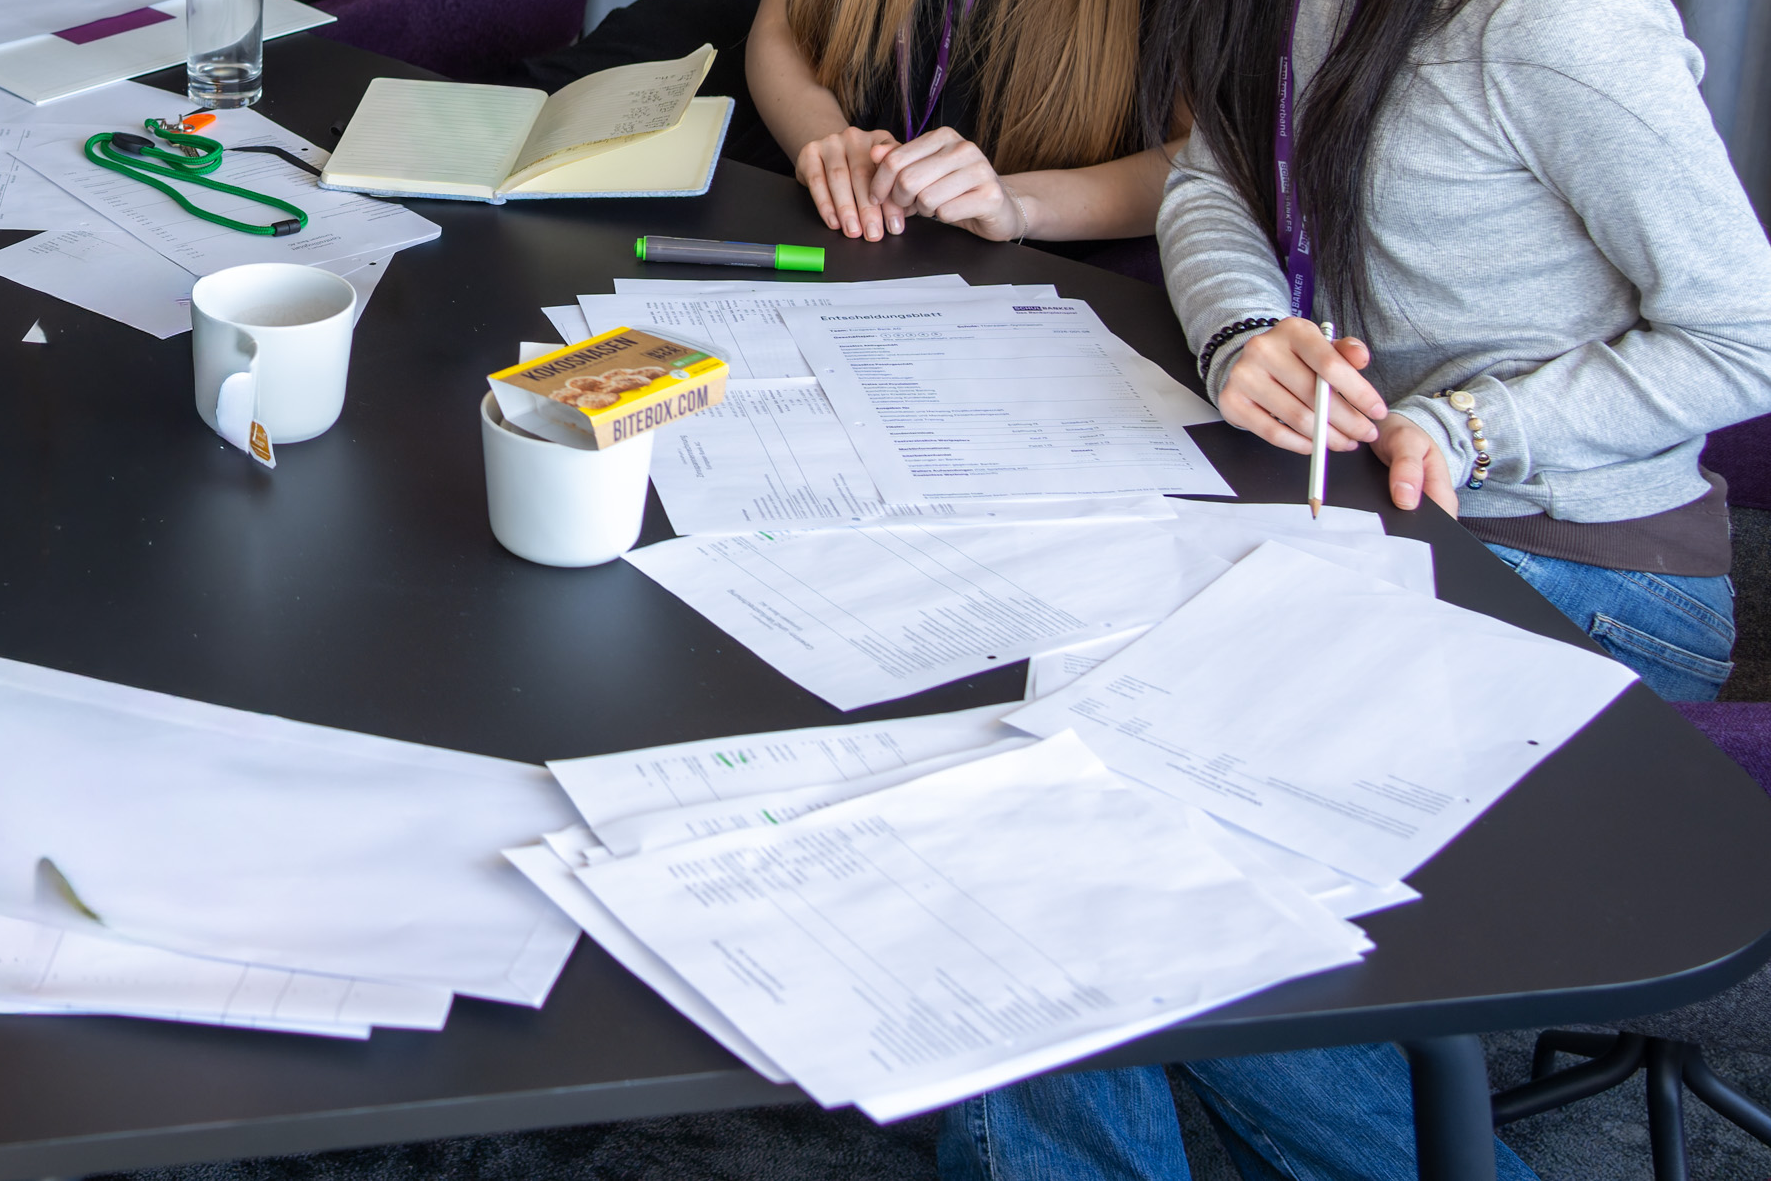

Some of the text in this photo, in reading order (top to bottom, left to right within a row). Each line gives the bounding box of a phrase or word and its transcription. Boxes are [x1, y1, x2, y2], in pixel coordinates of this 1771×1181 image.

[820, 312, 943, 322] Entscheidungsblatt
[520, 337, 639, 383] KOKOSNASEN
[612, 384, 709, 444] BITEBOX.COM
